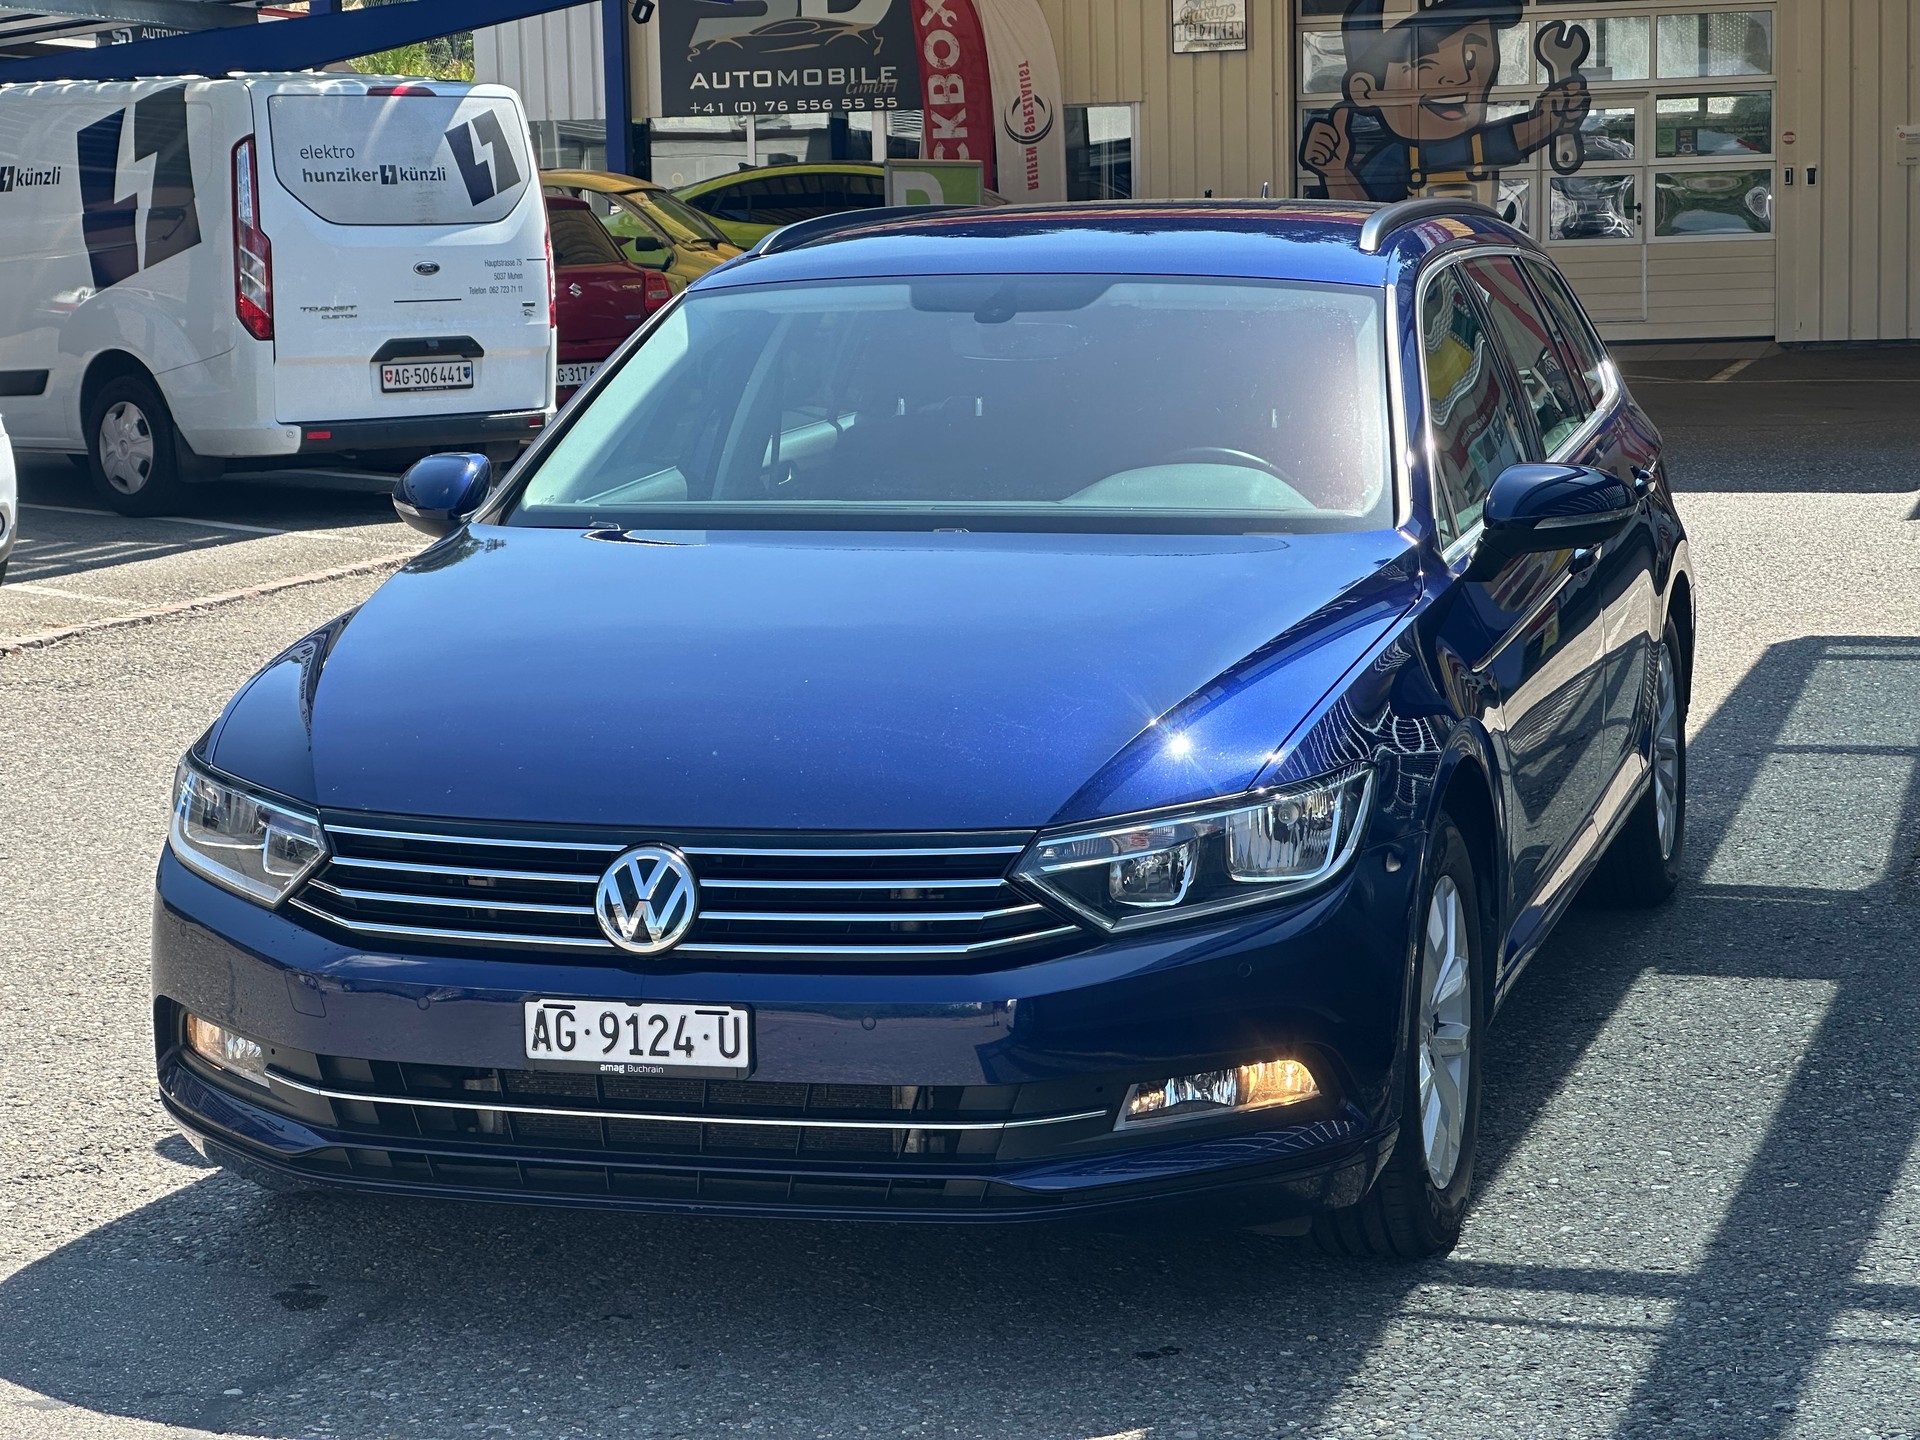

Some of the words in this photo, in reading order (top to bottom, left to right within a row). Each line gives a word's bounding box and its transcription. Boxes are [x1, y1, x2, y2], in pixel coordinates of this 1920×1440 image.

[1180, 4, 1236, 24] Garage
[1174, 22, 1243, 42] HOLZIKEN
[690, 66, 897, 90] AUTOMOBILE
[846, 76, 899, 96] GmbH
[690, 102, 724, 114] +41
[734, 101, 757, 113] (0)
[764, 101, 788, 112] 76
[797, 99, 833, 111] 556
[841, 98, 865, 109] 55
[874, 97, 898, 108] 55
[300, 144, 355, 159] elektro
[16, 166, 61, 187] künzli
[302, 167, 378, 182] hunziker
[400, 167, 447, 182] künzli
[484, 259, 515, 267] Hauptstrasse
[493, 272, 506, 280] 5037
[507, 272, 523, 280] Muhen
[469, 286, 487, 294] Telefon
[489, 286, 499, 294] 062
[500, 285, 509, 293] 723
[300, 305, 357, 313] TRANSIT
[600, 1064, 625, 1074] amag
[627, 1064, 664, 1074] Buchrain
